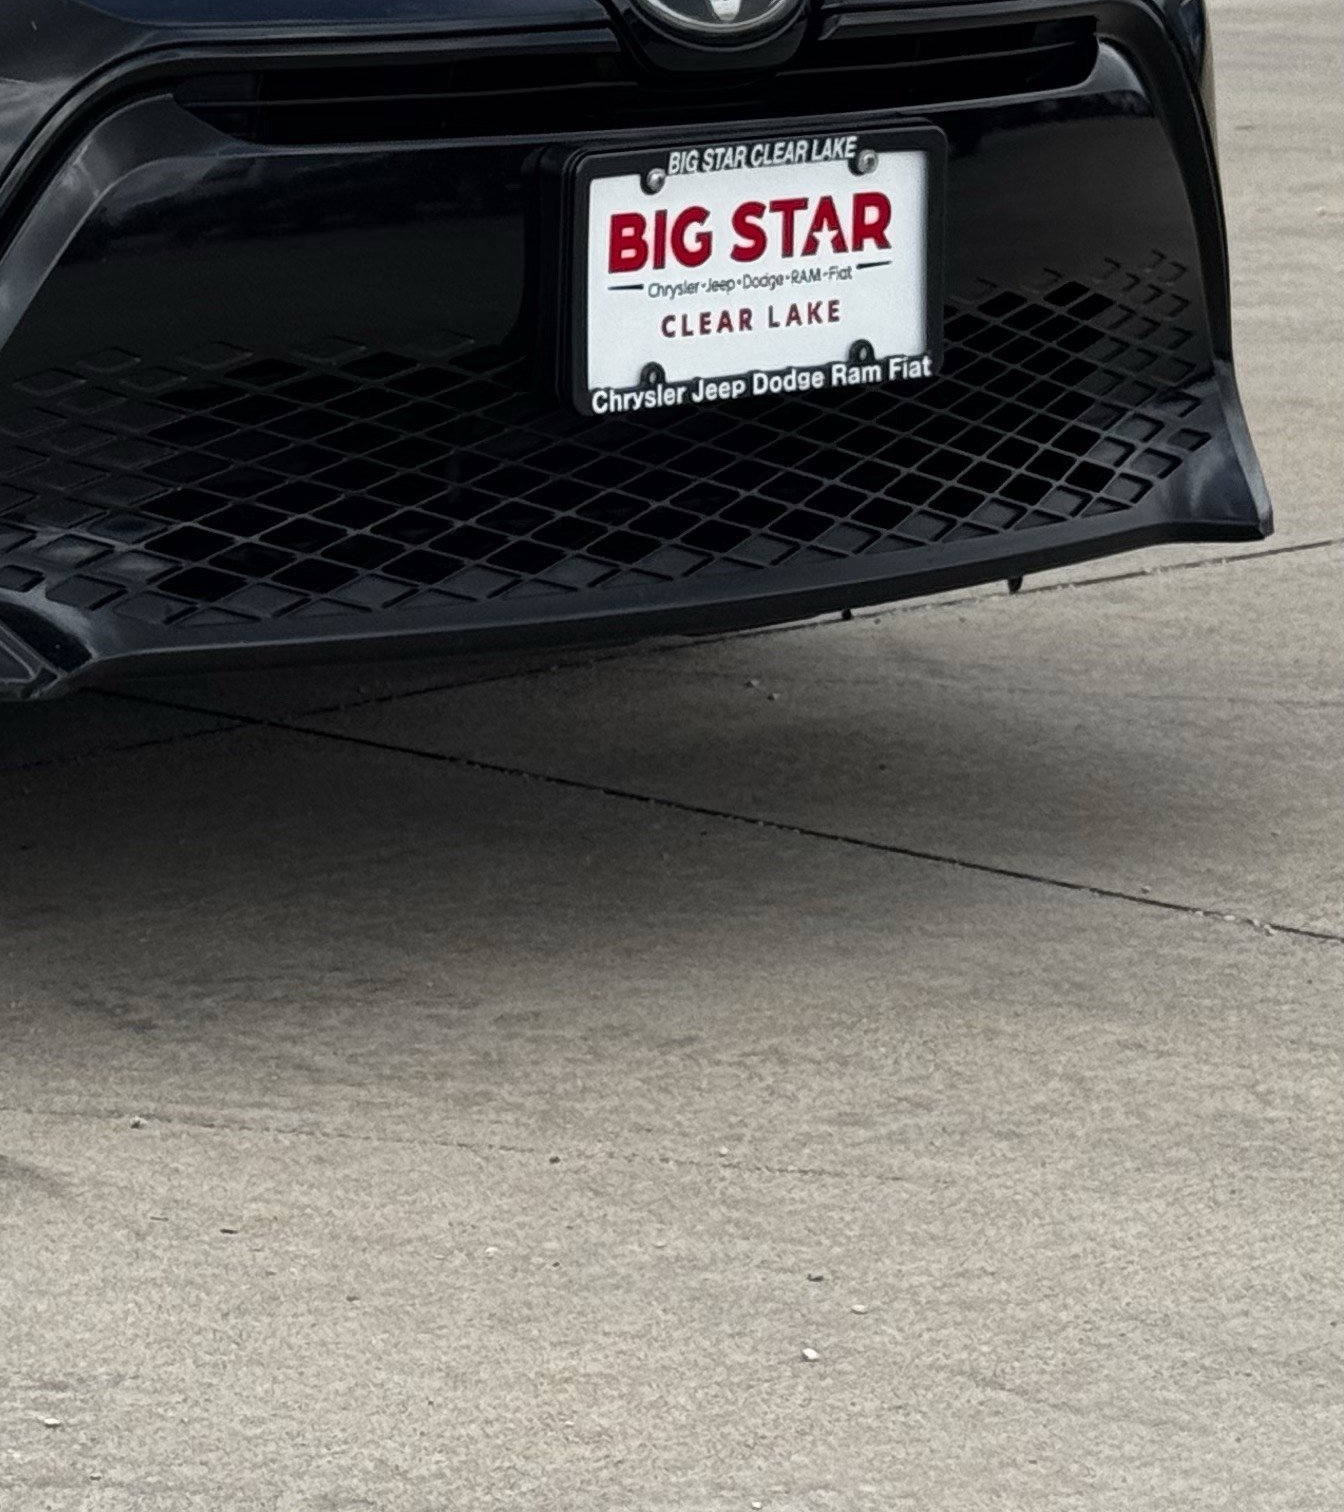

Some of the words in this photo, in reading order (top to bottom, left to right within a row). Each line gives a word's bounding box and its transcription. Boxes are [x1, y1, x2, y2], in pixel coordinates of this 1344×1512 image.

[668, 150, 699, 175] BIG
[702, 146, 747, 171] STAR
[750, 140, 808, 168] CLEAR
[811, 136, 858, 161] LAKE
[608, 206, 713, 274] BIG
[730, 192, 892, 262] STAR
[661, 308, 753, 338] CLEAR
[768, 299, 840, 328] LAKE
[591, 384, 687, 414] Chrysler
[691, 377, 746, 403] Jeep
[752, 369, 825, 396] Dodge
[831, 361, 882, 387] Ram
[888, 355, 933, 381] Fiat
